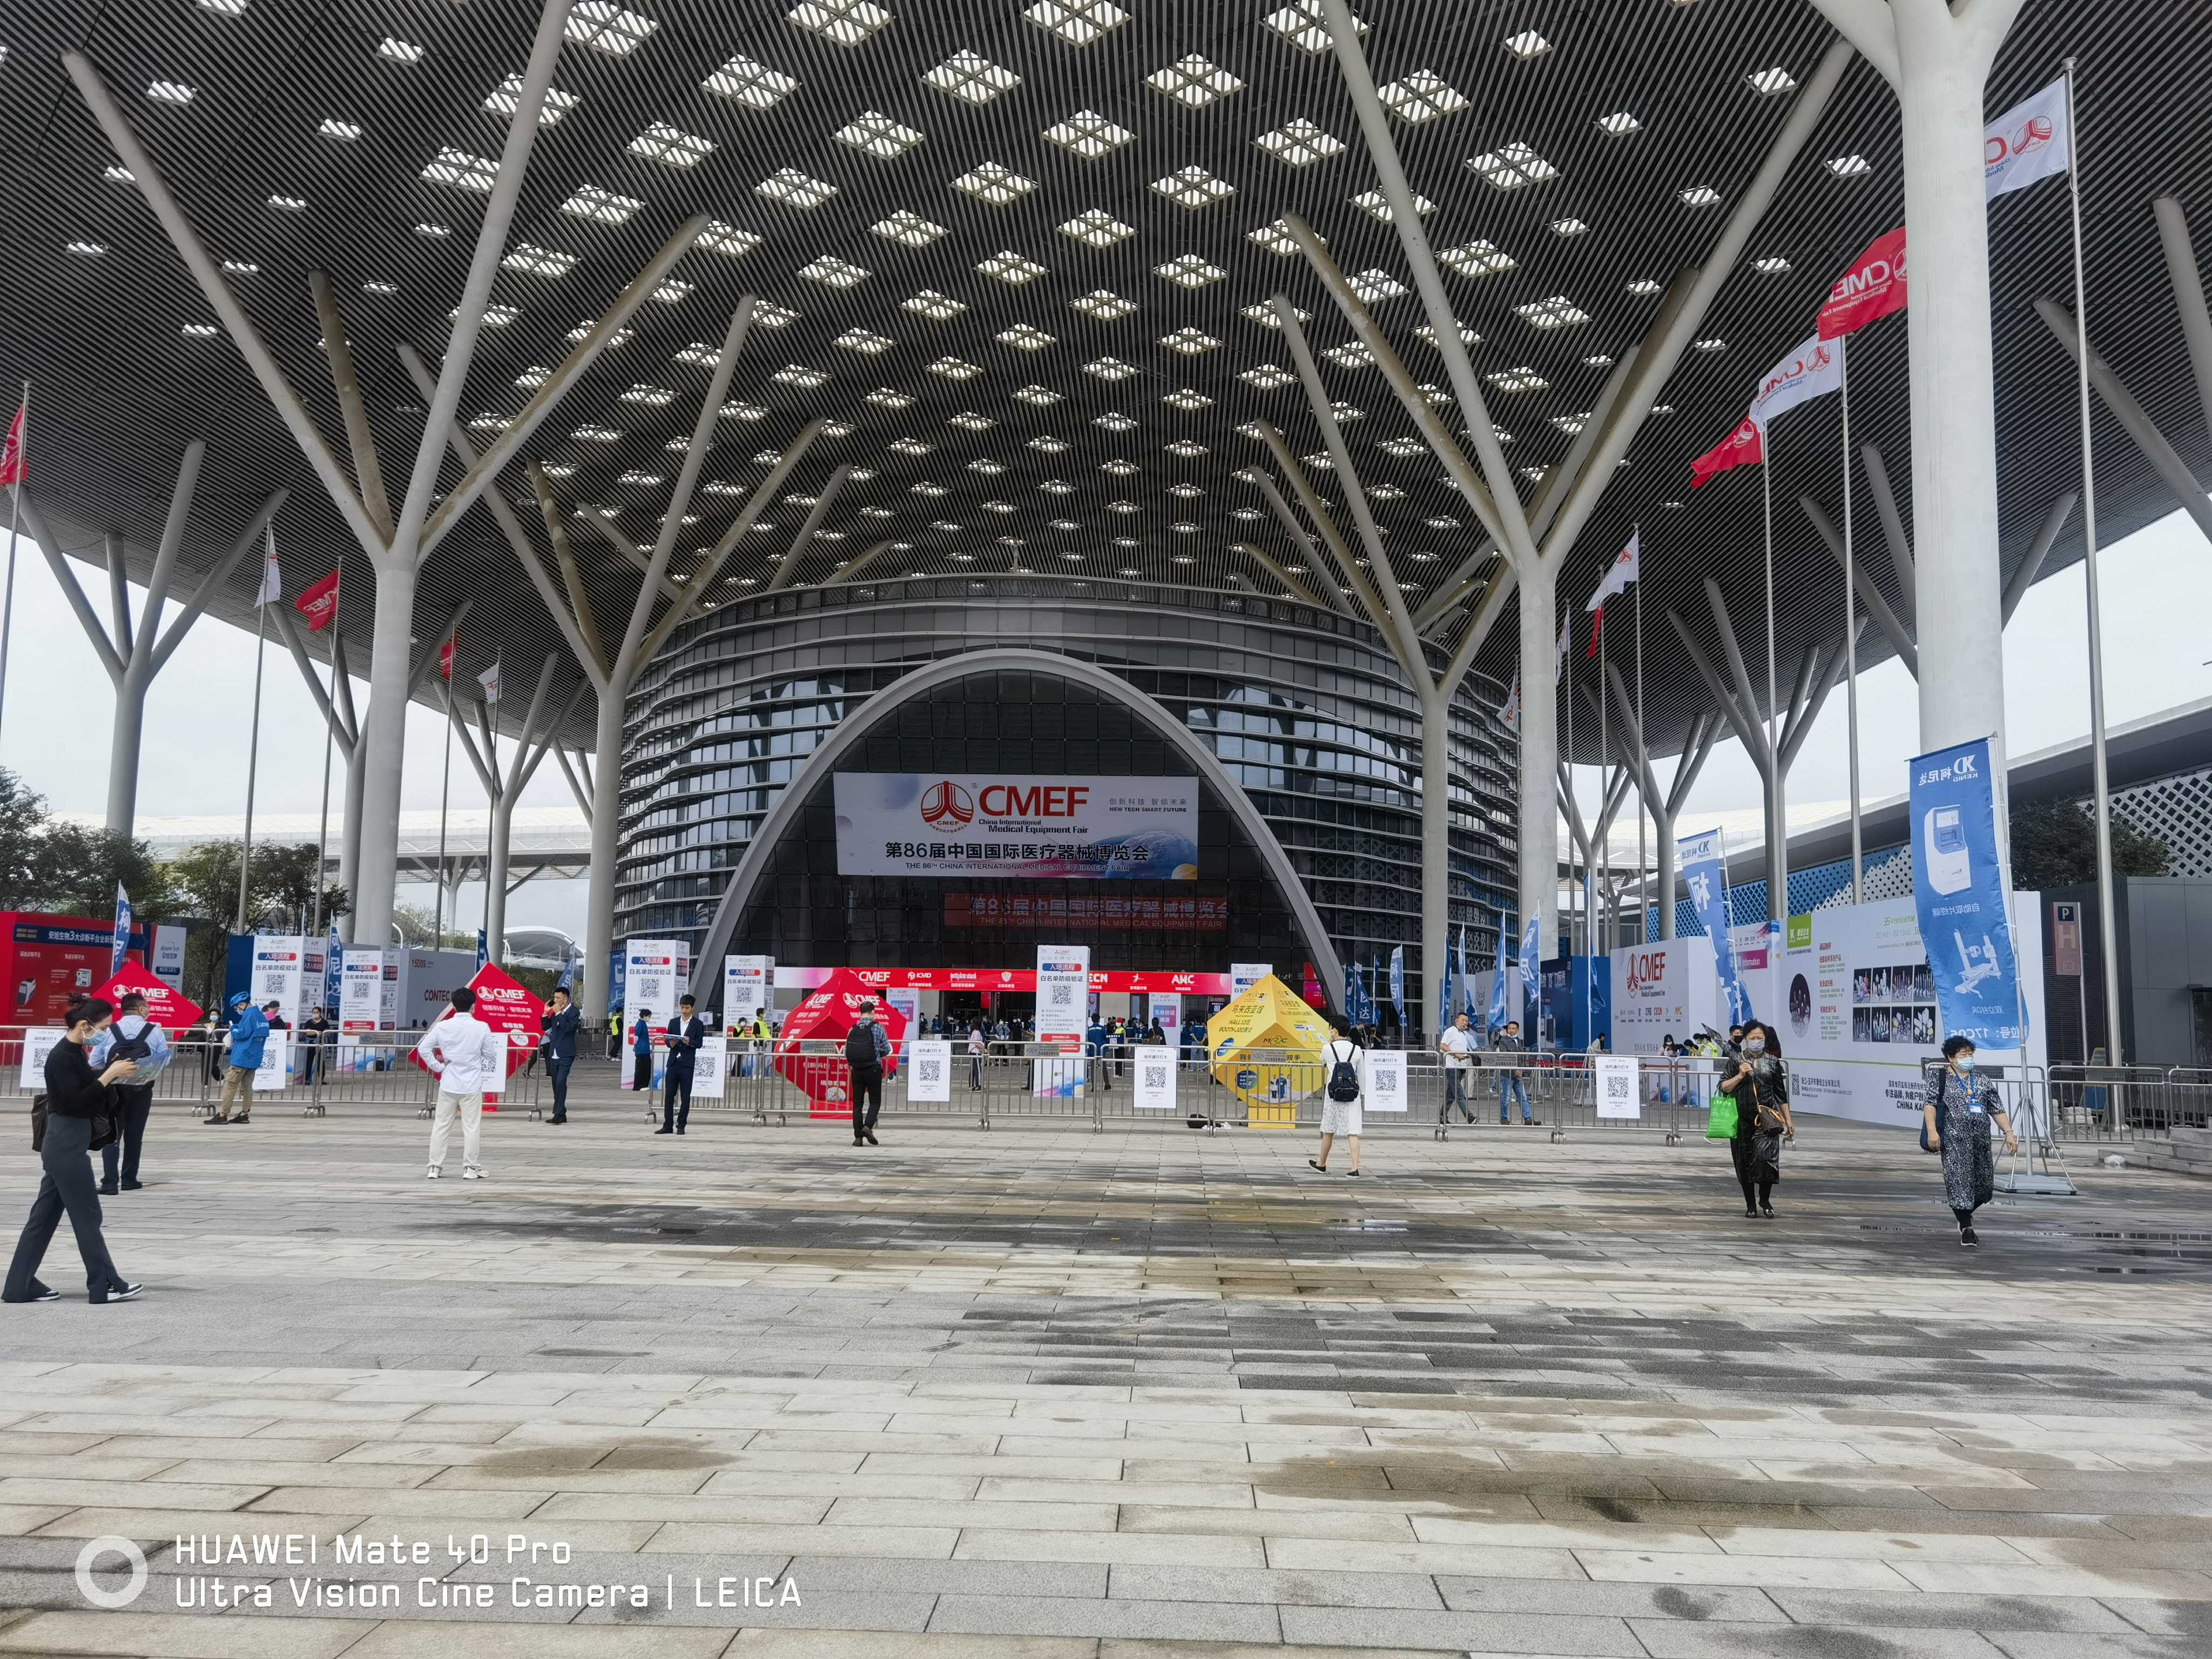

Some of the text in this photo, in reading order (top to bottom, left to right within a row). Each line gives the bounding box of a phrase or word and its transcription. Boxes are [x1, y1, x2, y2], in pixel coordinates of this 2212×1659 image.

[979, 785, 1089, 817] CMEF
[1026, 826, 1070, 834] Equipment
[885, 841, 1149, 861] 第86届中国国际医疗器械博览会
[2062, 907, 2069, 920] P
[1639, 952, 1666, 982] CMEF
[859, 972, 891, 982] CMEF
[1088, 973, 1108, 983] ECN
[424, 989, 450, 1002] CONTEC
[494, 988, 525, 1000] CMEF
[1897, 1101, 1913, 1110] CHINA
